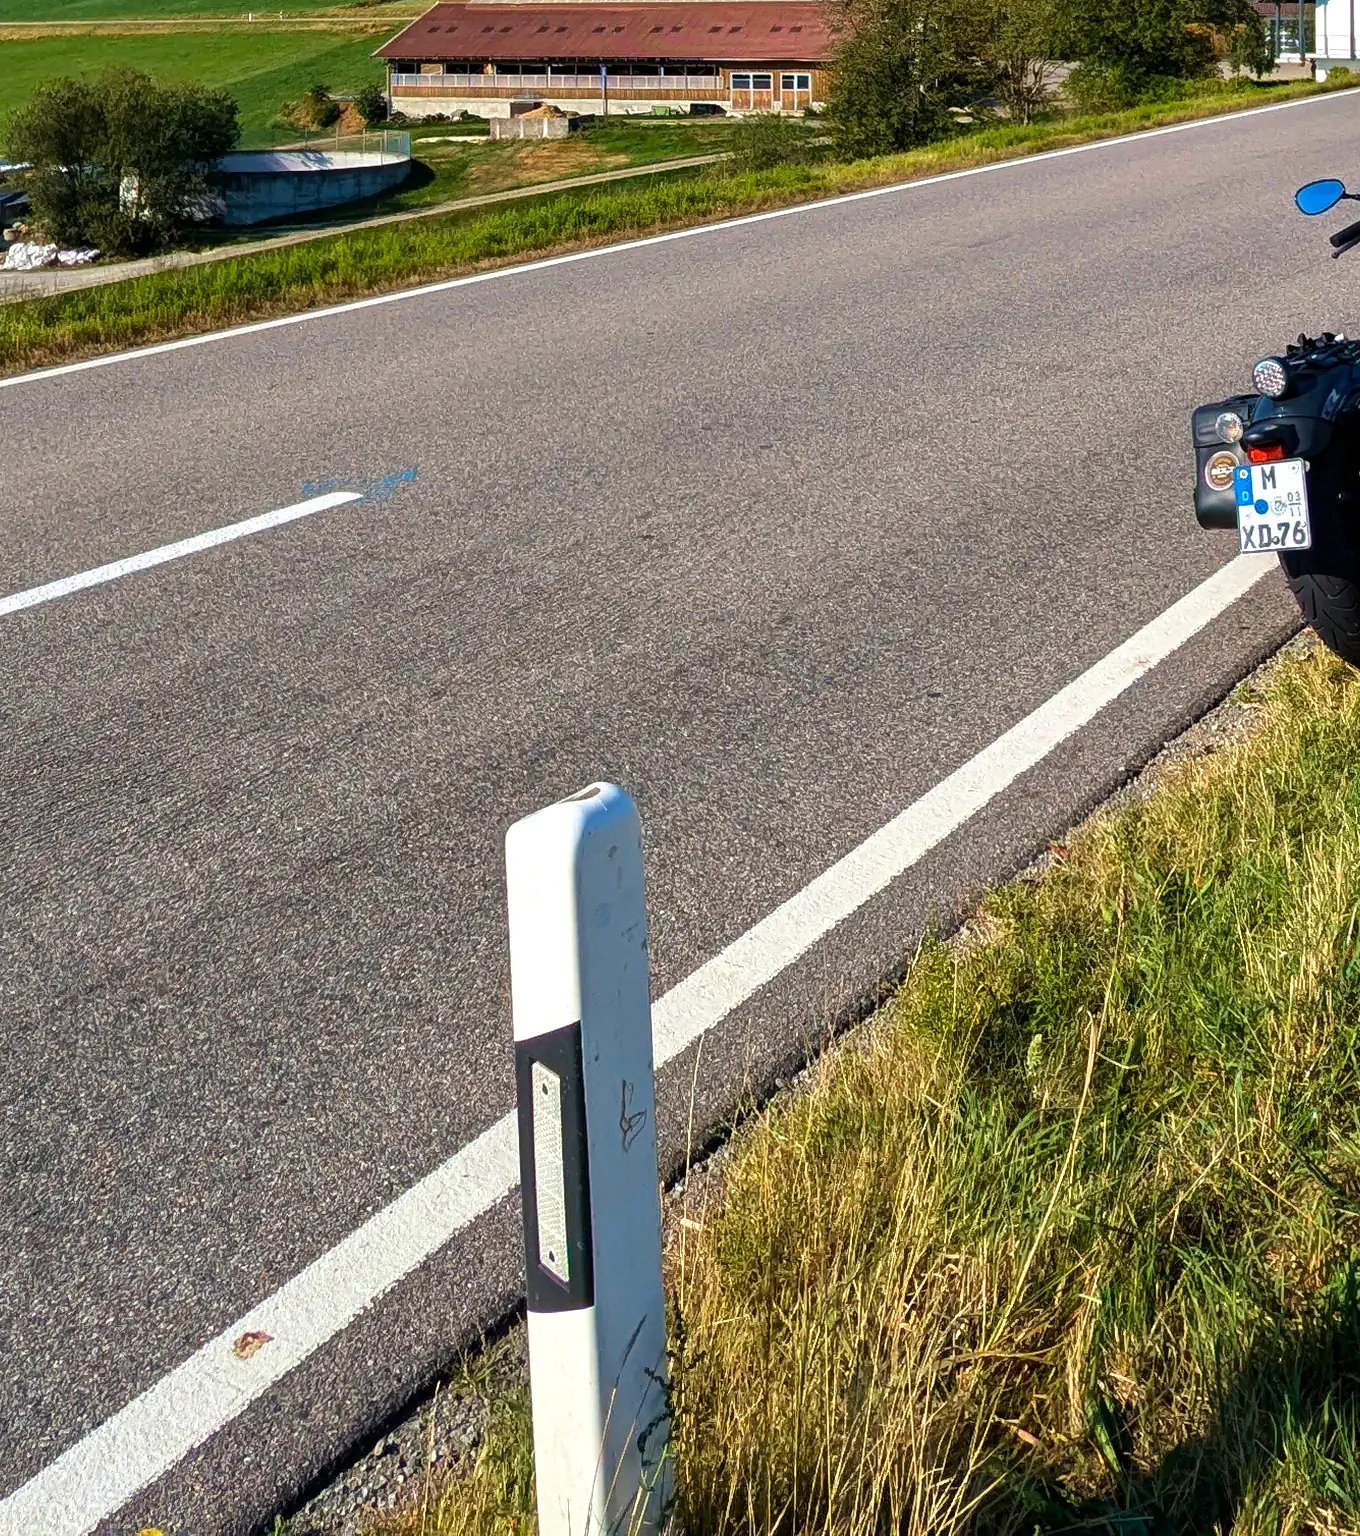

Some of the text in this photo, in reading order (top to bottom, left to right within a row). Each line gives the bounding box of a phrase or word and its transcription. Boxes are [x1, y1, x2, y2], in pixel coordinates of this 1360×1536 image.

[1261, 466, 1276, 490] M
[1242, 491, 1249, 501] D
[1287, 490, 1301, 502] 03
[1290, 506, 1301, 517] 11
